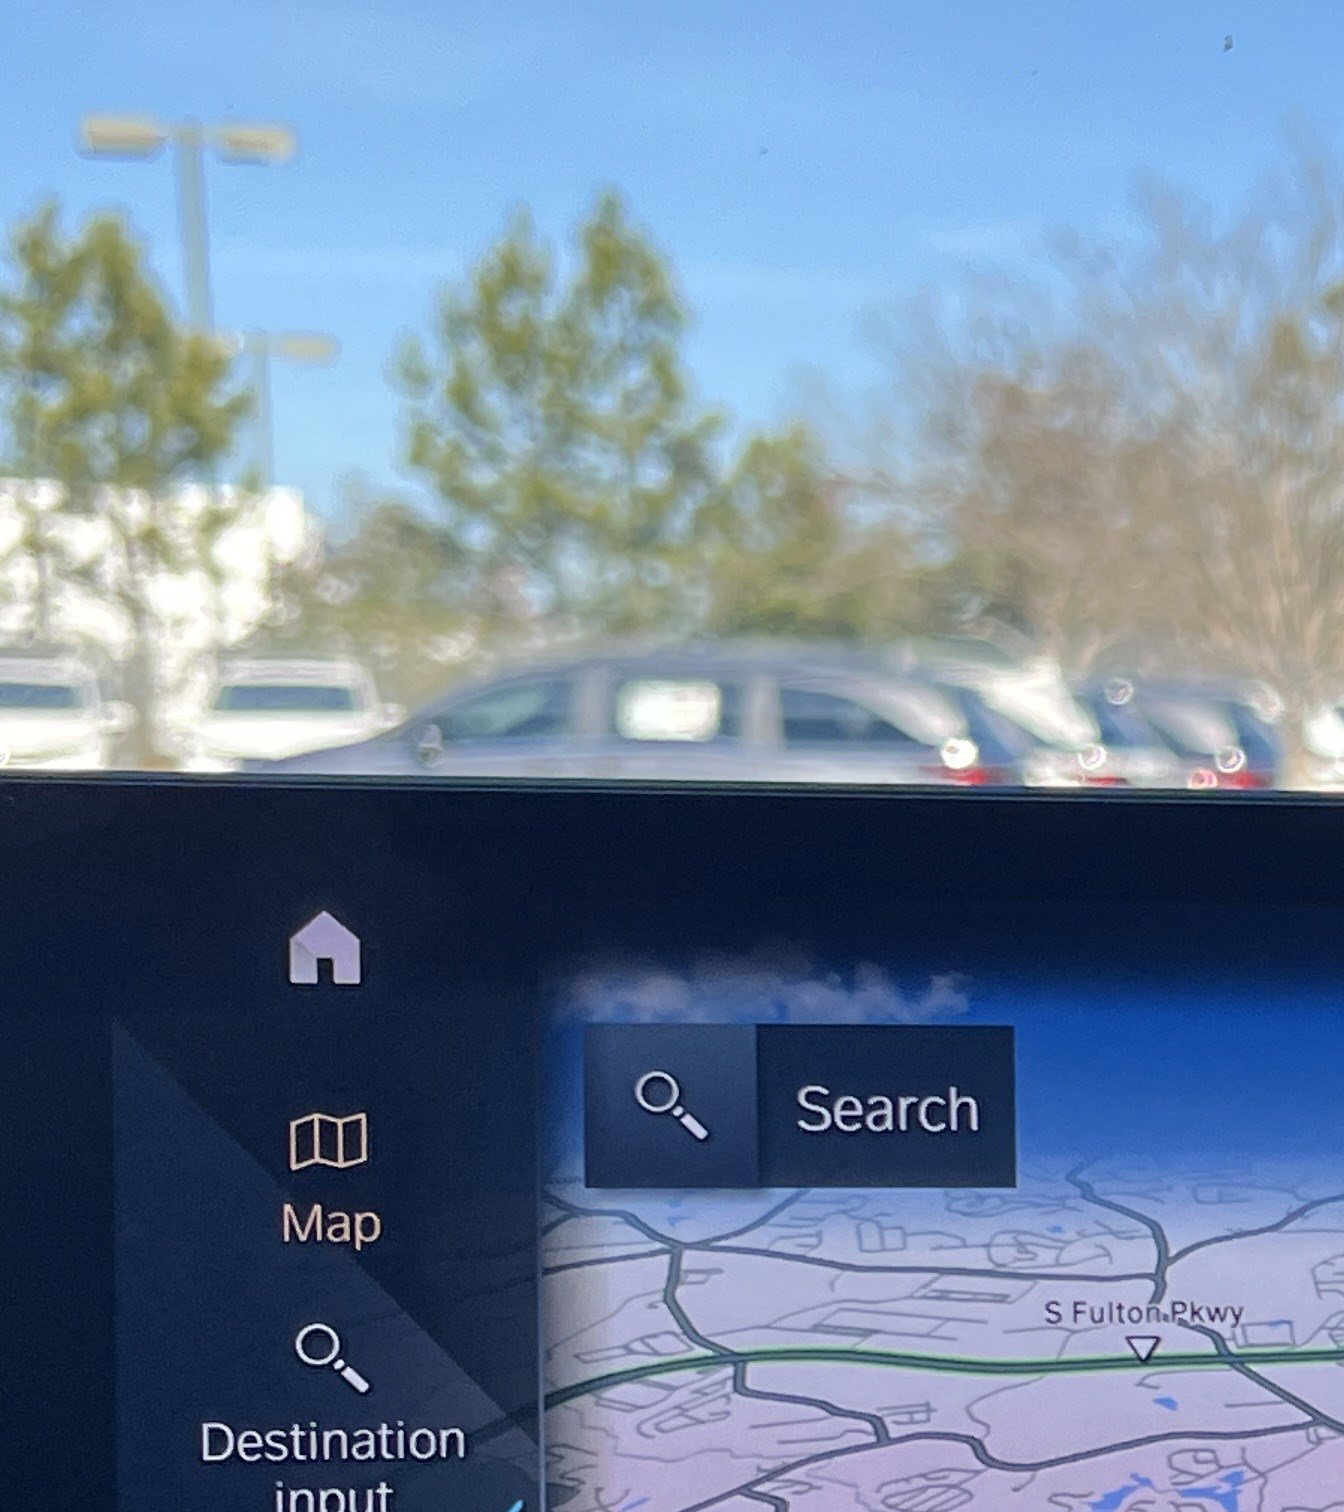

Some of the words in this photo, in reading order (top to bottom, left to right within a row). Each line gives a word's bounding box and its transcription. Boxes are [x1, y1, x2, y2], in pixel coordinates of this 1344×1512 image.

[798, 1086, 978, 1131] Search
[284, 1204, 380, 1250] Map
[1045, 1302, 1064, 1324] S
[1071, 1300, 1160, 1324] Fulton
[1170, 1300, 1244, 1327] Pkwy
[203, 1421, 464, 1461] Destination
